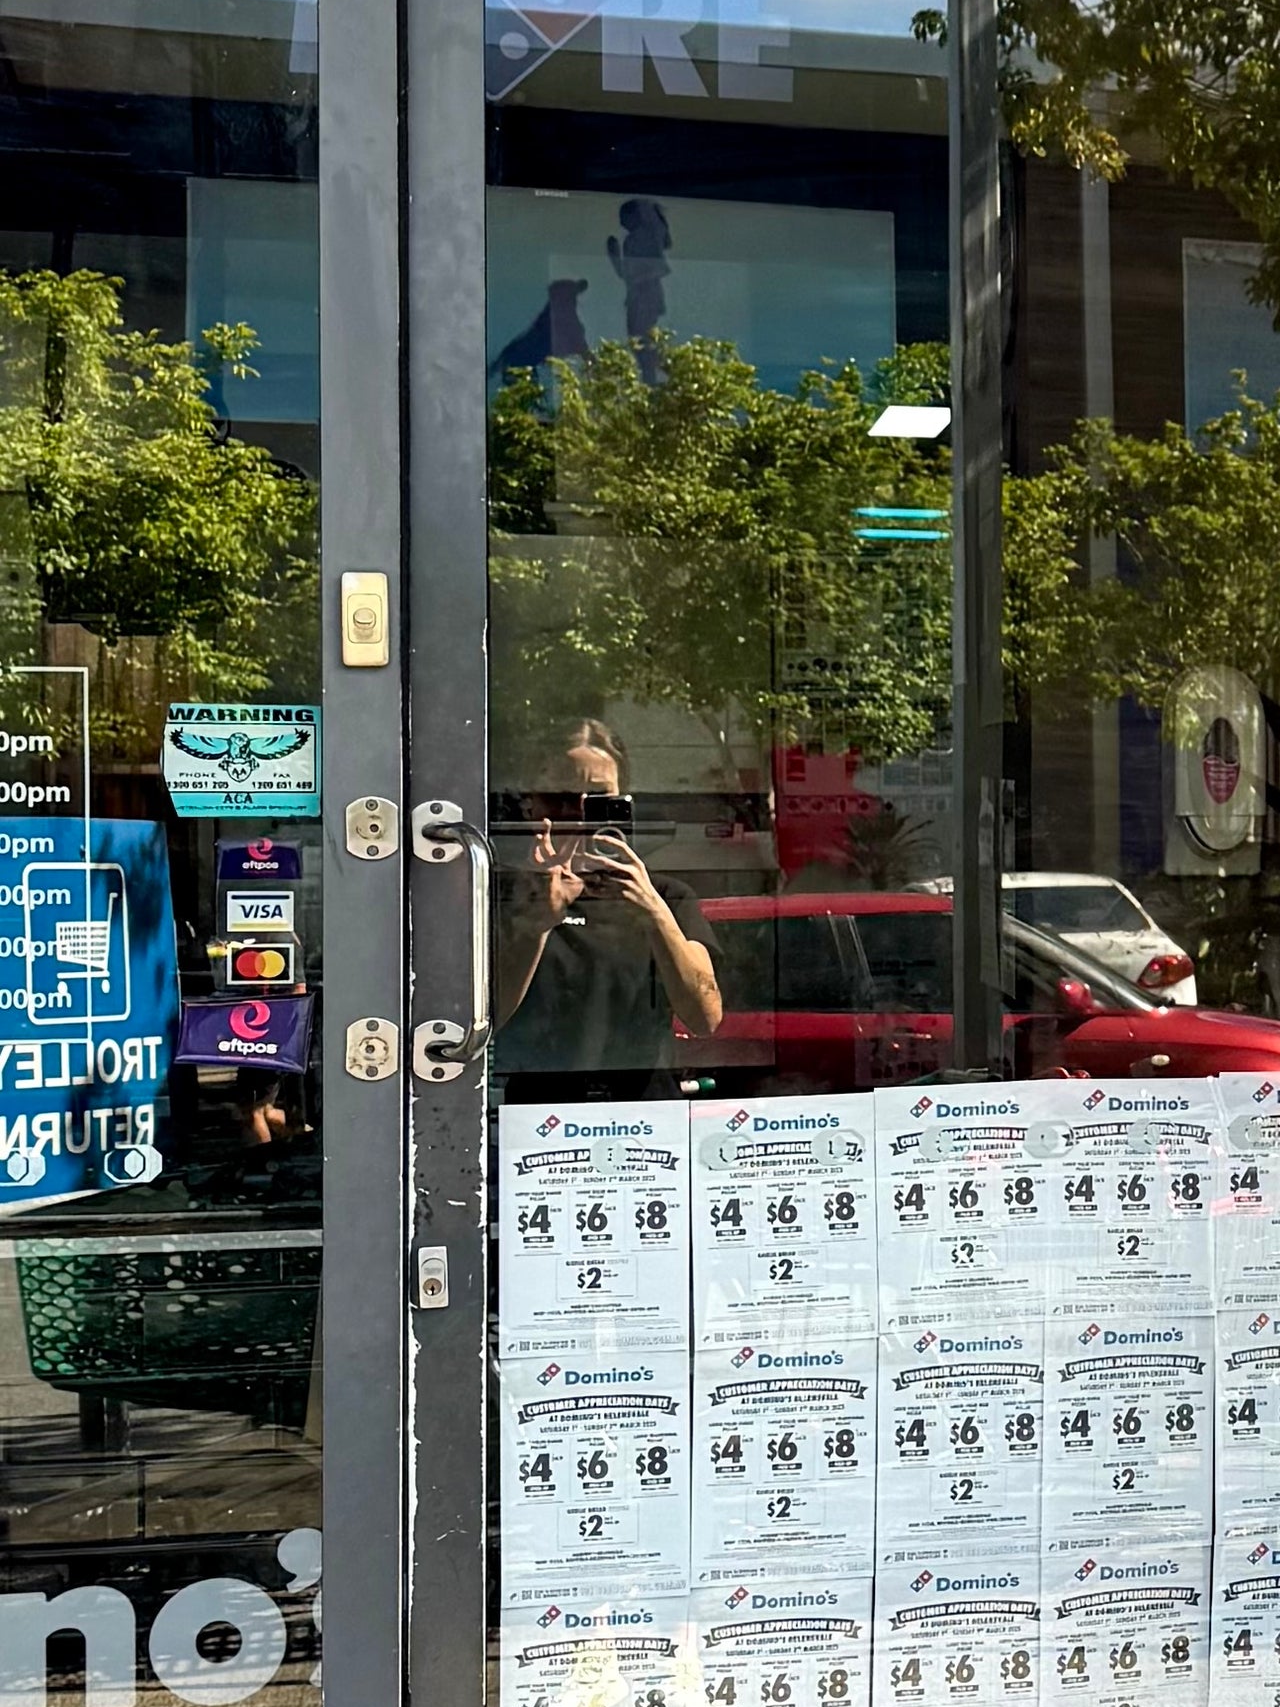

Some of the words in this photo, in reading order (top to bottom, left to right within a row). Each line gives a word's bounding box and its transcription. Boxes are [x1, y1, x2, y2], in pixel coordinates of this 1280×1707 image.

[168, 708, 315, 722] WARNING
[223, 793, 254, 804] ACA
[242, 860, 279, 871] eftpos
[240, 904, 283, 919] VISA
[217, 1038, 278, 1056] eftpos
[564, 1120, 654, 1138] Domino's
[518, 1204, 551, 1234] $4
[576, 1202, 608, 1232] $6
[635, 1200, 667, 1230] $8
